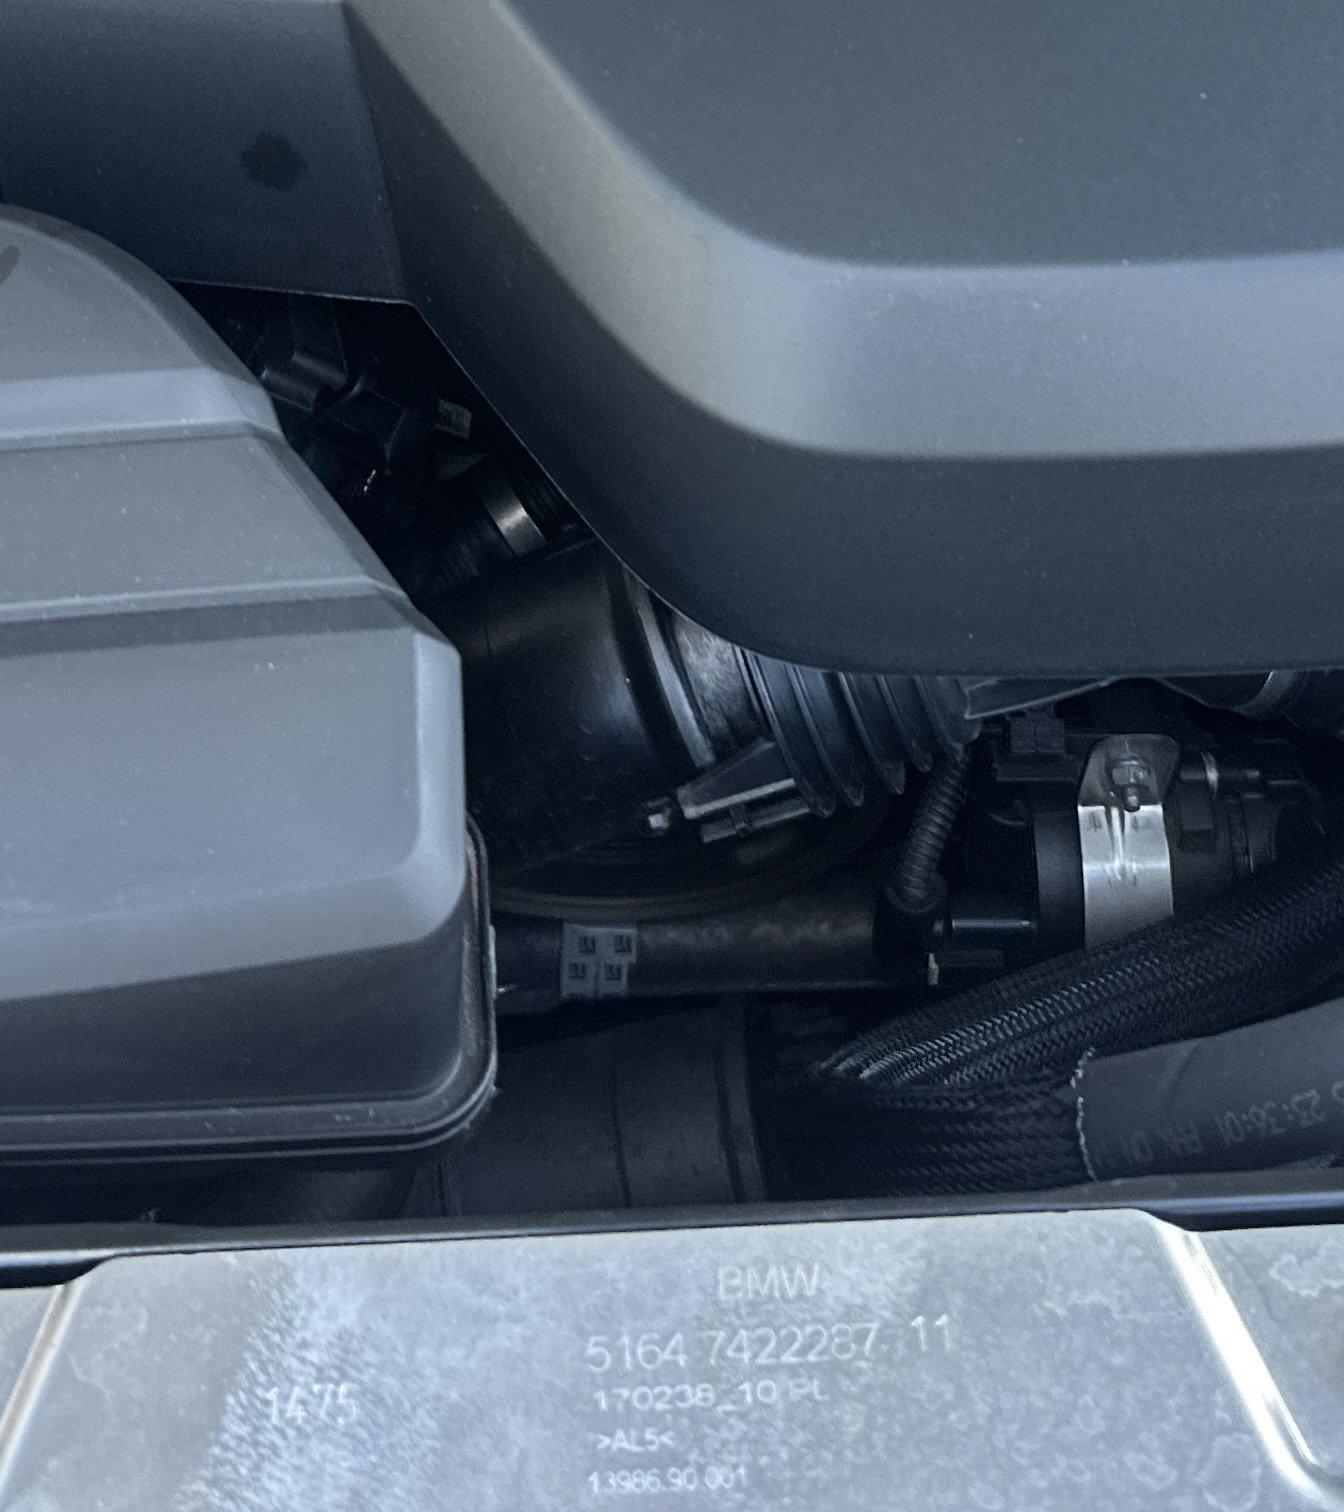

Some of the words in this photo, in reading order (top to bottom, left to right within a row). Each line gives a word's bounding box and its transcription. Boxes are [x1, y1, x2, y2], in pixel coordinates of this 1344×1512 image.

[718, 1262, 820, 1302] BMW
[585, 1333, 689, 1373] 5164
[699, 1321, 880, 1365] 7422287
[910, 1314, 954, 1354] 11
